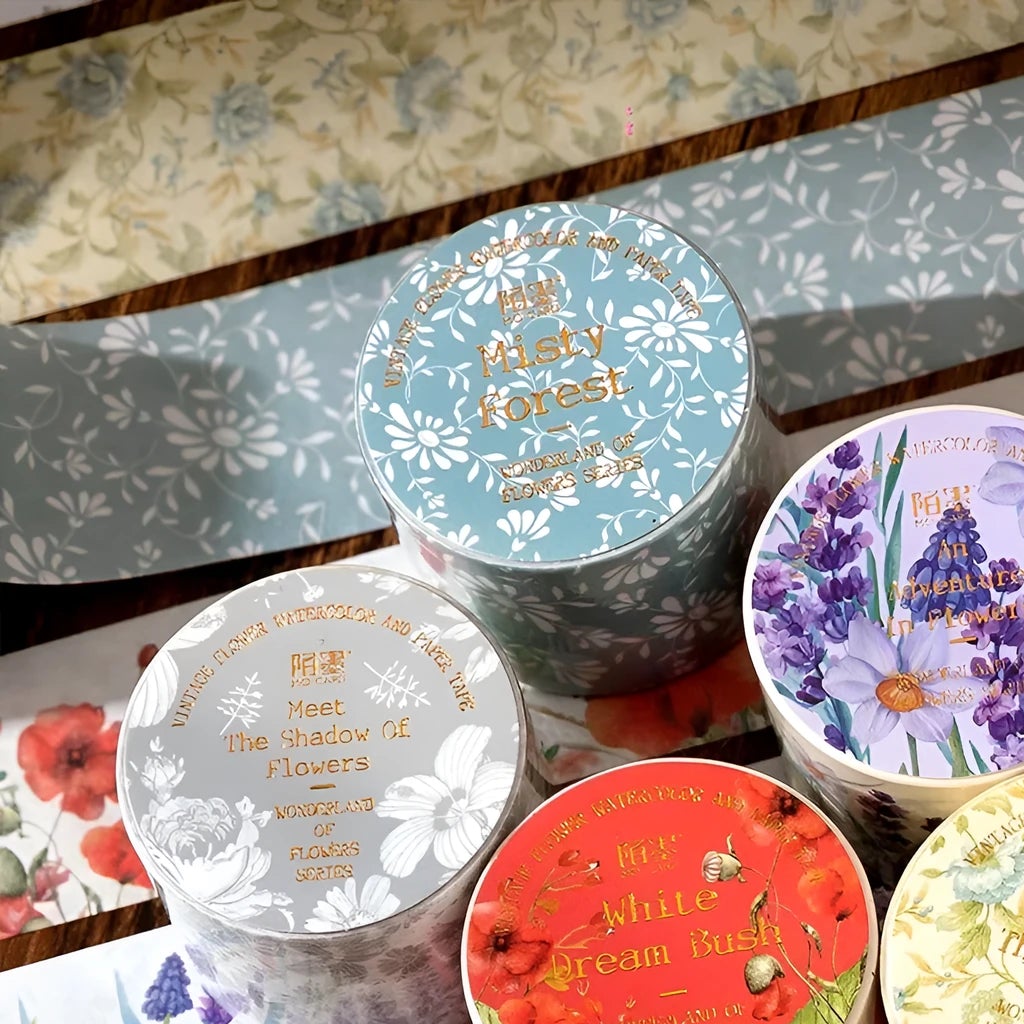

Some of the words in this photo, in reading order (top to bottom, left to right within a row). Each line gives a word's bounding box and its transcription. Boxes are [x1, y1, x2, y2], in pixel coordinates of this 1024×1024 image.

[475, 323, 605, 379] Misty
[478, 366, 635, 429] Forest
[381, 614, 412, 636] AND
[287, 699, 346, 720] Meet
[223, 731, 270, 753] The
[280, 724, 370, 749] Shadow
[381, 717, 412, 740] Of
[265, 756, 371, 780] Flowers
[313, 822, 337, 838] OF
[289, 841, 361, 861] FLOWERS
[602, 889, 720, 929] White
[550, 943, 672, 982] Dream
[688, 914, 783, 960] Bush
